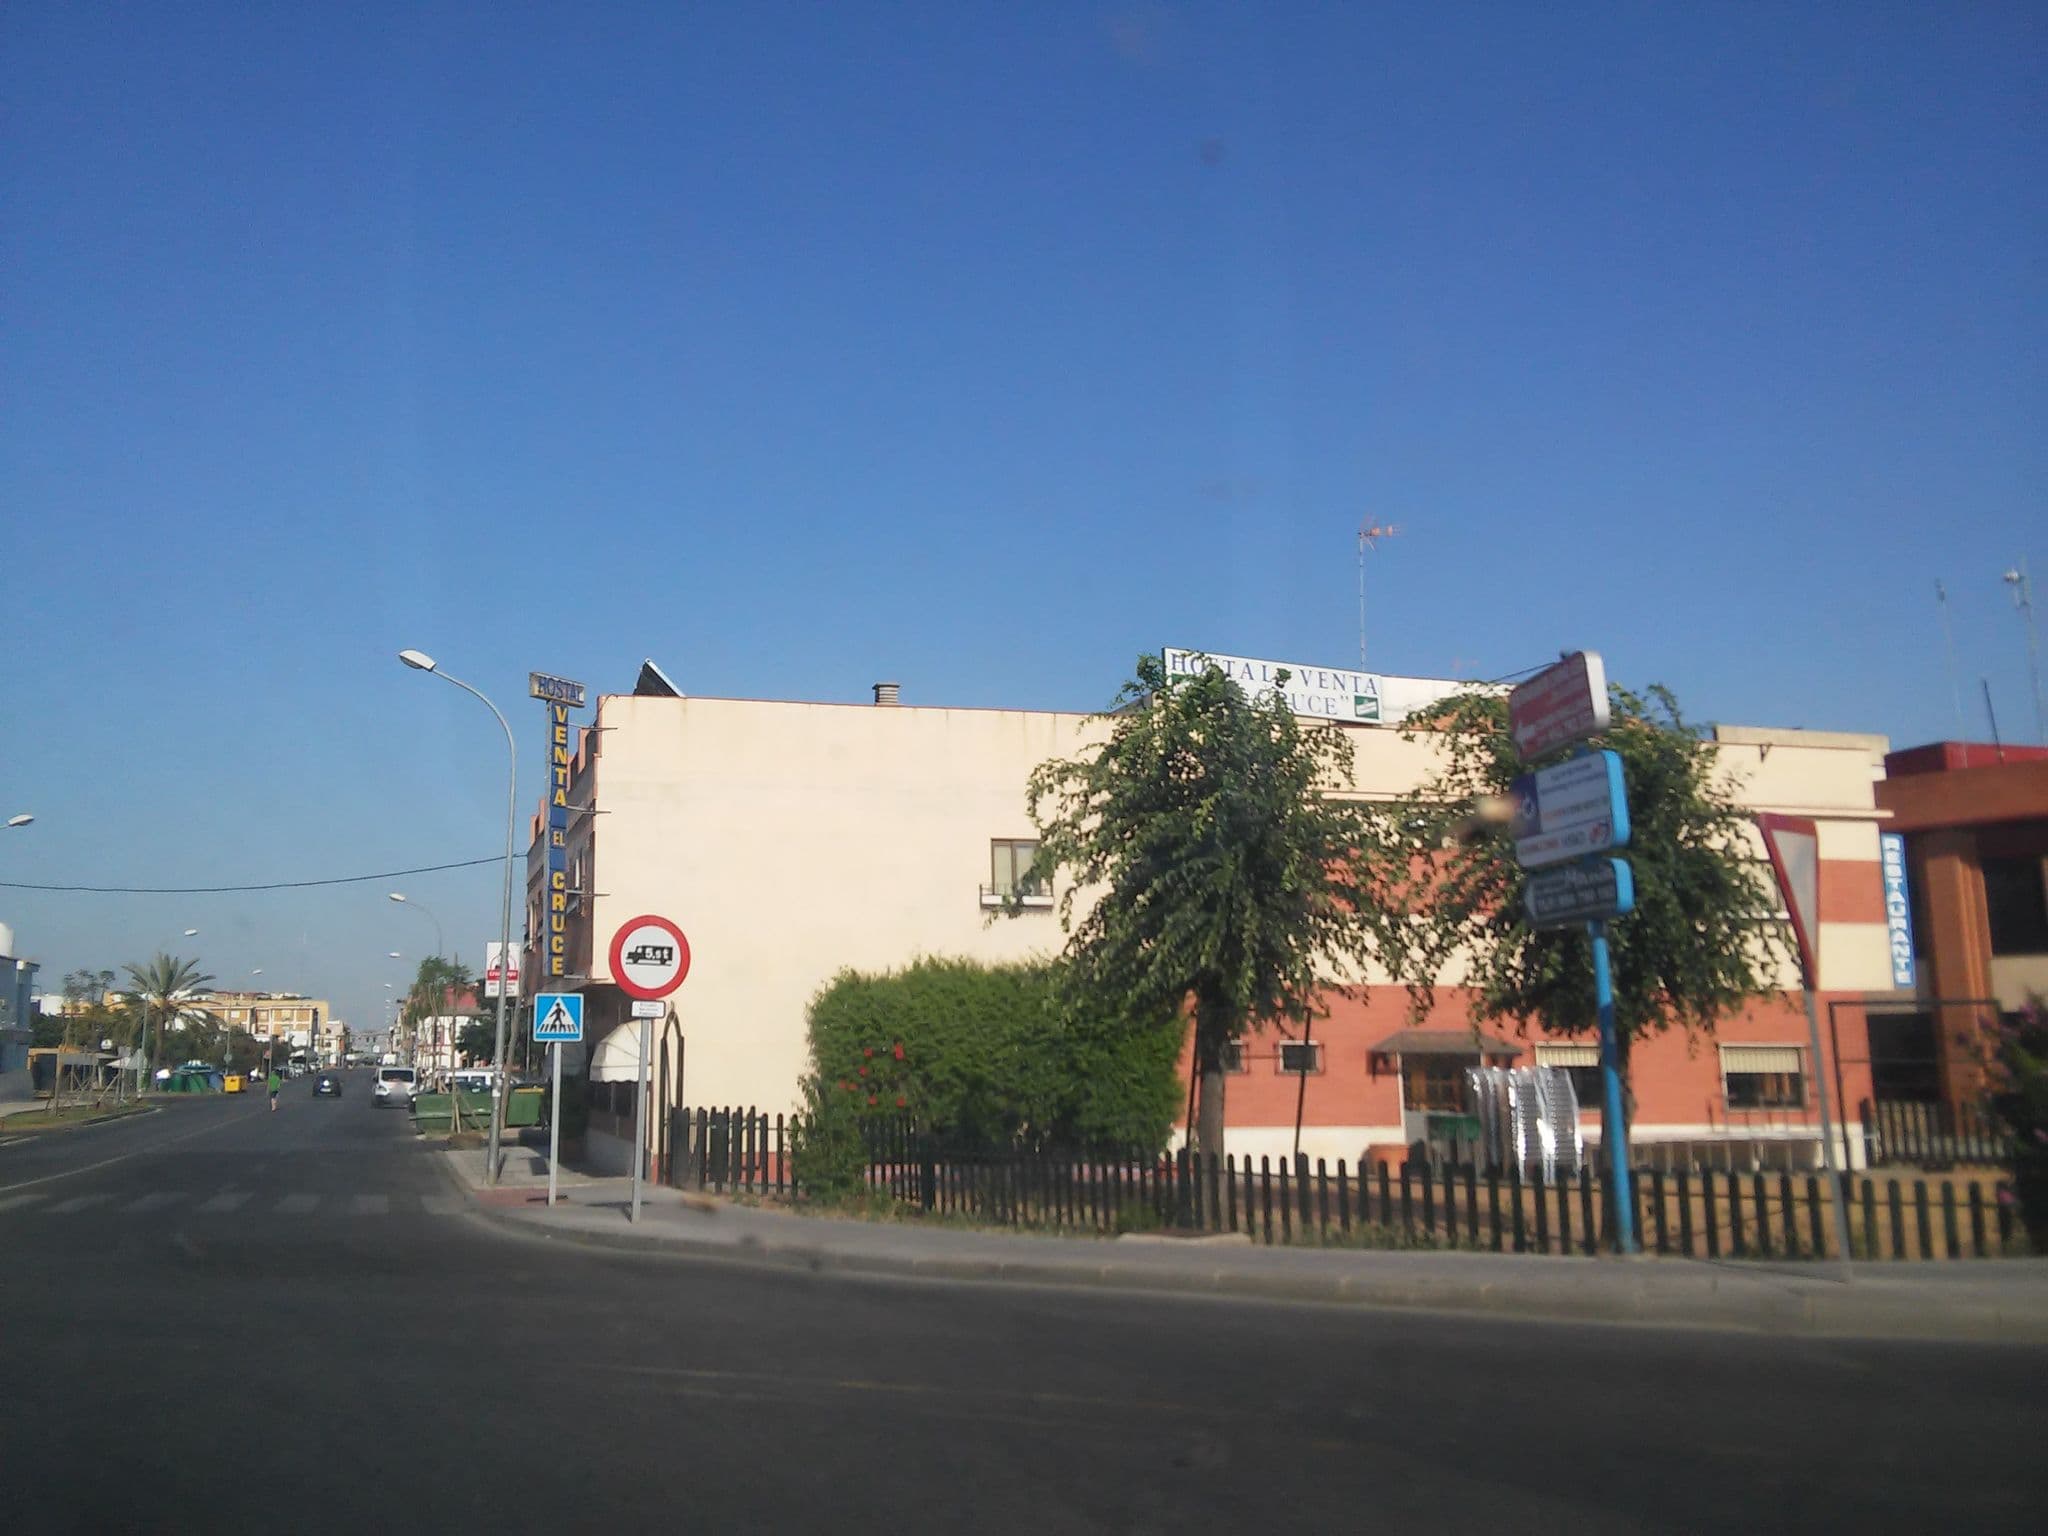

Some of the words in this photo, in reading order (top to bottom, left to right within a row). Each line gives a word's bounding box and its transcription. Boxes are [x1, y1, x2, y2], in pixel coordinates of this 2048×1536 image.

[538, 677, 584, 703] HOSTAL
[1300, 669, 1378, 695] VENTA
[553, 705, 567, 807] VENTA
[552, 829, 565, 847] EL
[551, 872, 566, 976] CRUCE
[1883, 836, 1913, 984] RESTAURANTE
